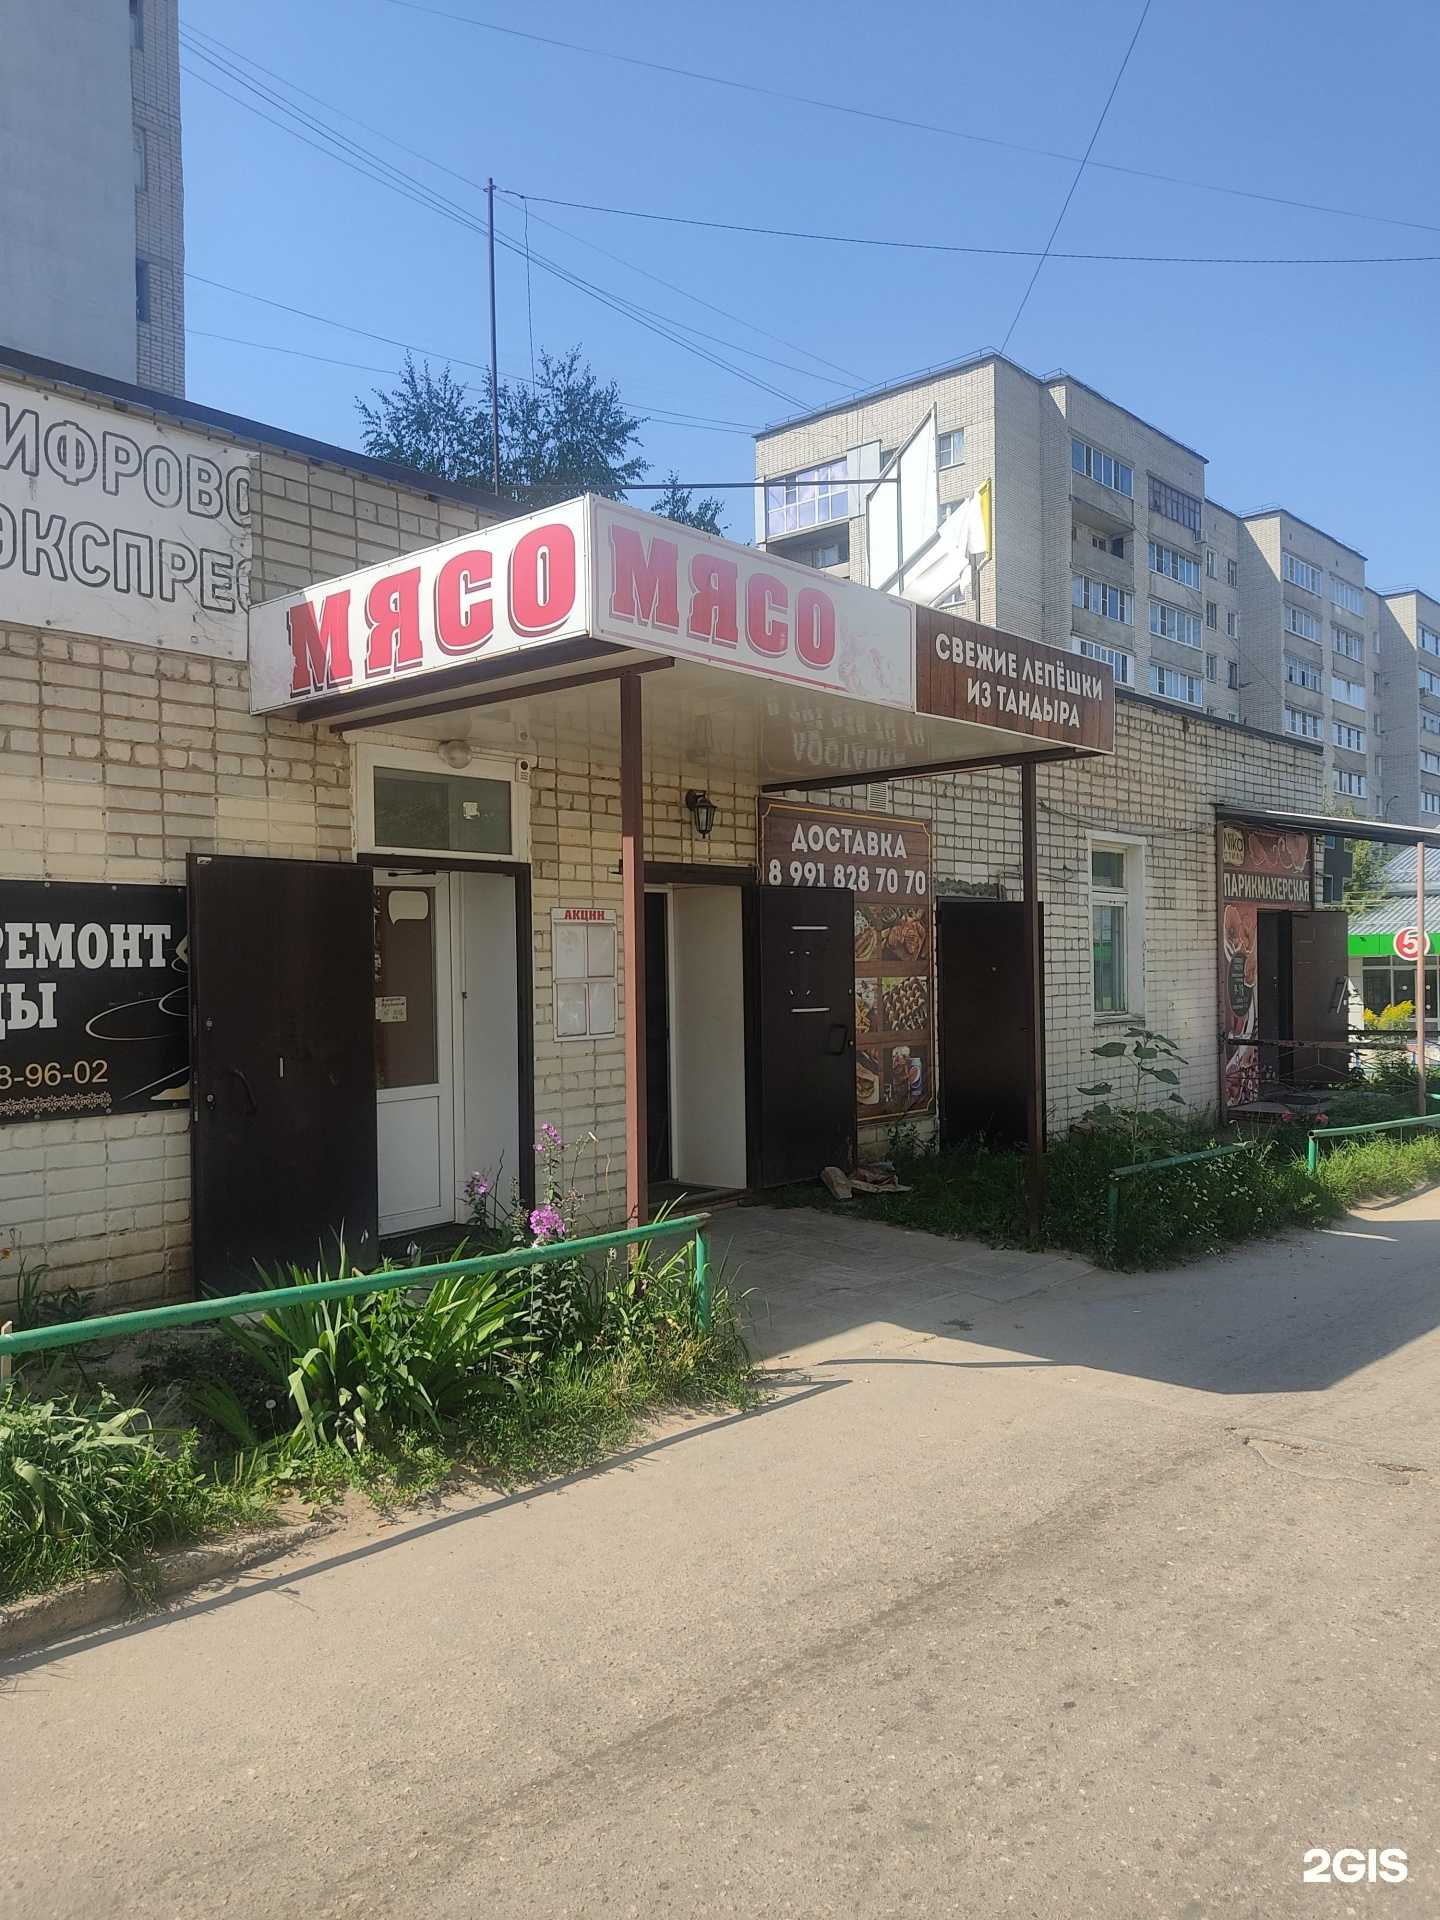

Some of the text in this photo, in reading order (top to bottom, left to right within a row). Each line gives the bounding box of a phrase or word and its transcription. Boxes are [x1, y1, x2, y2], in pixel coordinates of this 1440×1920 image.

[287, 523, 576, 698] МЯСО
[609, 524, 836, 670] МЯСО
[935, 633, 1103, 700] СВЕЖИЕ ЛЕПЁШКИ
[967, 677, 1080, 728] ИЗ ТАНДЫРА
[791, 823, 908, 859] ДОСТАВКА
[768, 858, 926, 895] 8 991 828 70 70
[1223, 872, 1310, 902] ПАРИКМАХЕРСКАЯ
[564, 909, 605, 922] АКЦИИ
[0, 922, 172, 969] ЕМОНТ
